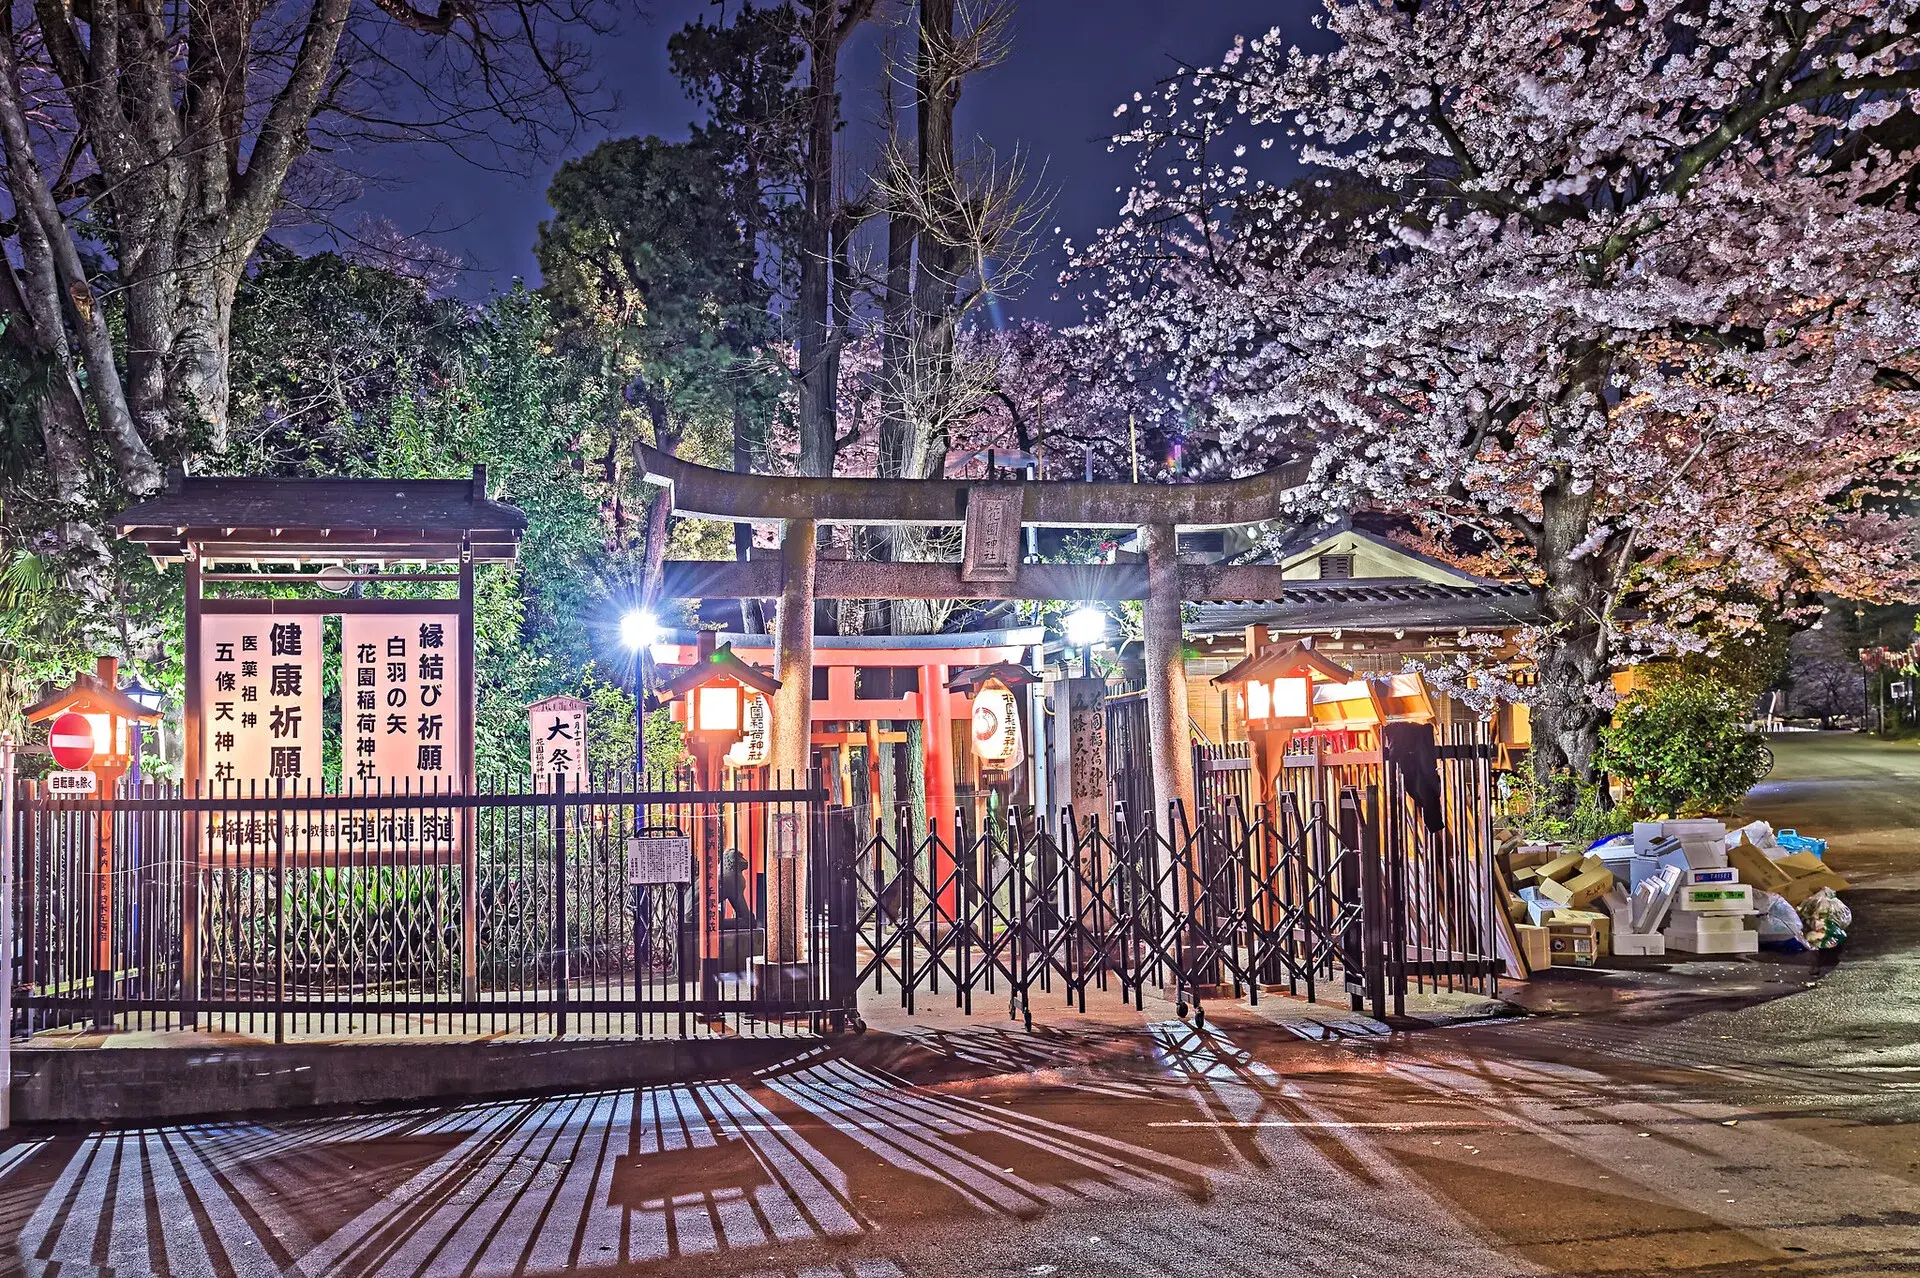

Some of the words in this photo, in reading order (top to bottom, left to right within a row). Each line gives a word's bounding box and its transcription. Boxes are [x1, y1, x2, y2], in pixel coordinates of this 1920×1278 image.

[214, 642, 236, 782] 五條天神社
[241, 635, 258, 729] 医薬祖神
[269, 622, 303, 779] 健康祈願
[356, 643, 377, 781] 花園稲荷神社
[386, 635, 408, 735] 白羽の矢
[417, 622, 444, 771] 縁結び祈願
[53, 776, 92, 789] 自転車を除く
[546, 716, 574, 772] 大祭
